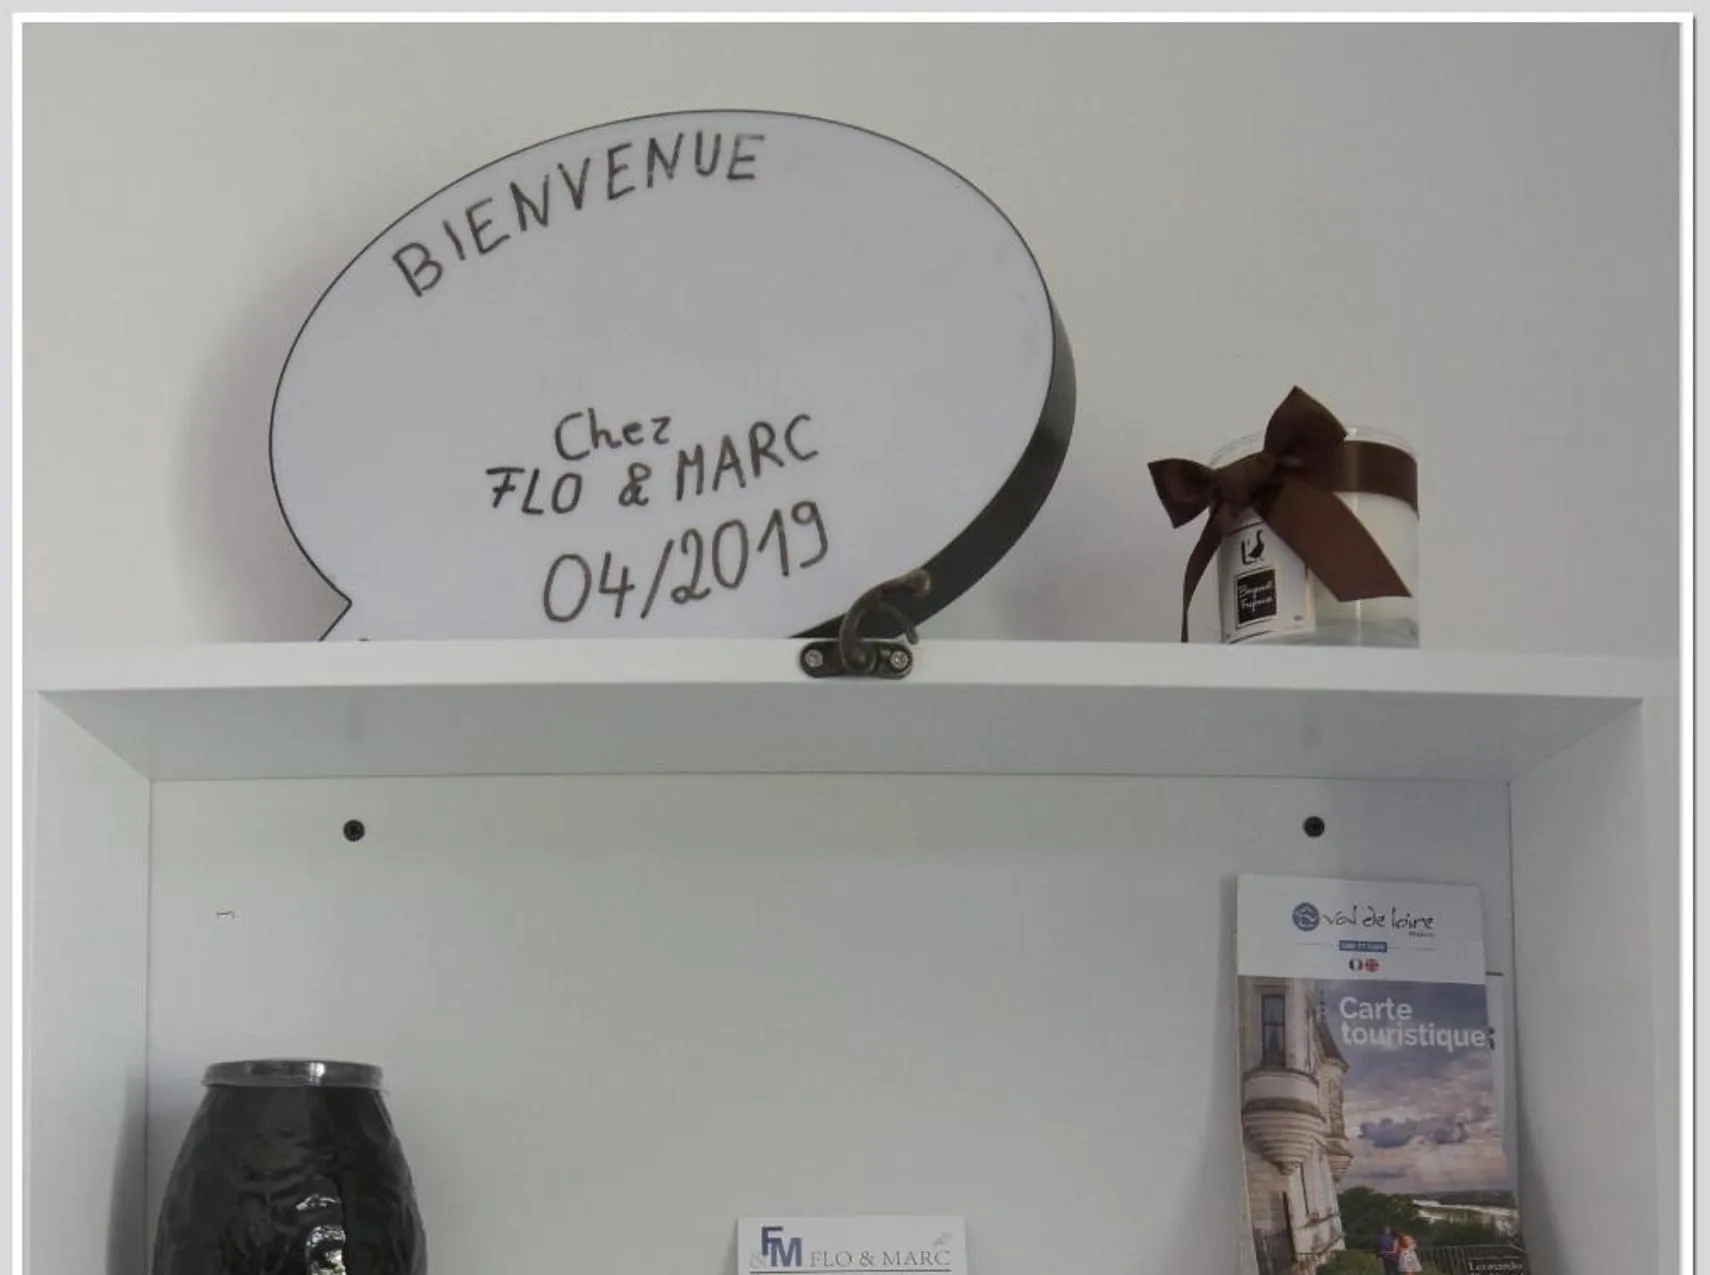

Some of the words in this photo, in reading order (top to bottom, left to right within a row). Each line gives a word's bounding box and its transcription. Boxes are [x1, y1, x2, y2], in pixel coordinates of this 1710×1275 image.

[392, 131, 766, 298] BIENVENUE
[554, 406, 673, 462] Chez
[486, 466, 582, 515] FLO
[617, 462, 651, 508] &
[675, 414, 820, 502] MARC
[542, 500, 830, 623] 04/2019
[1339, 996, 1413, 1021] Carte
[1340, 1021, 1488, 1053] touristique
[809, 1250, 852, 1268] FLO
[859, 1250, 876, 1267] &
[882, 1249, 951, 1267] MARC
